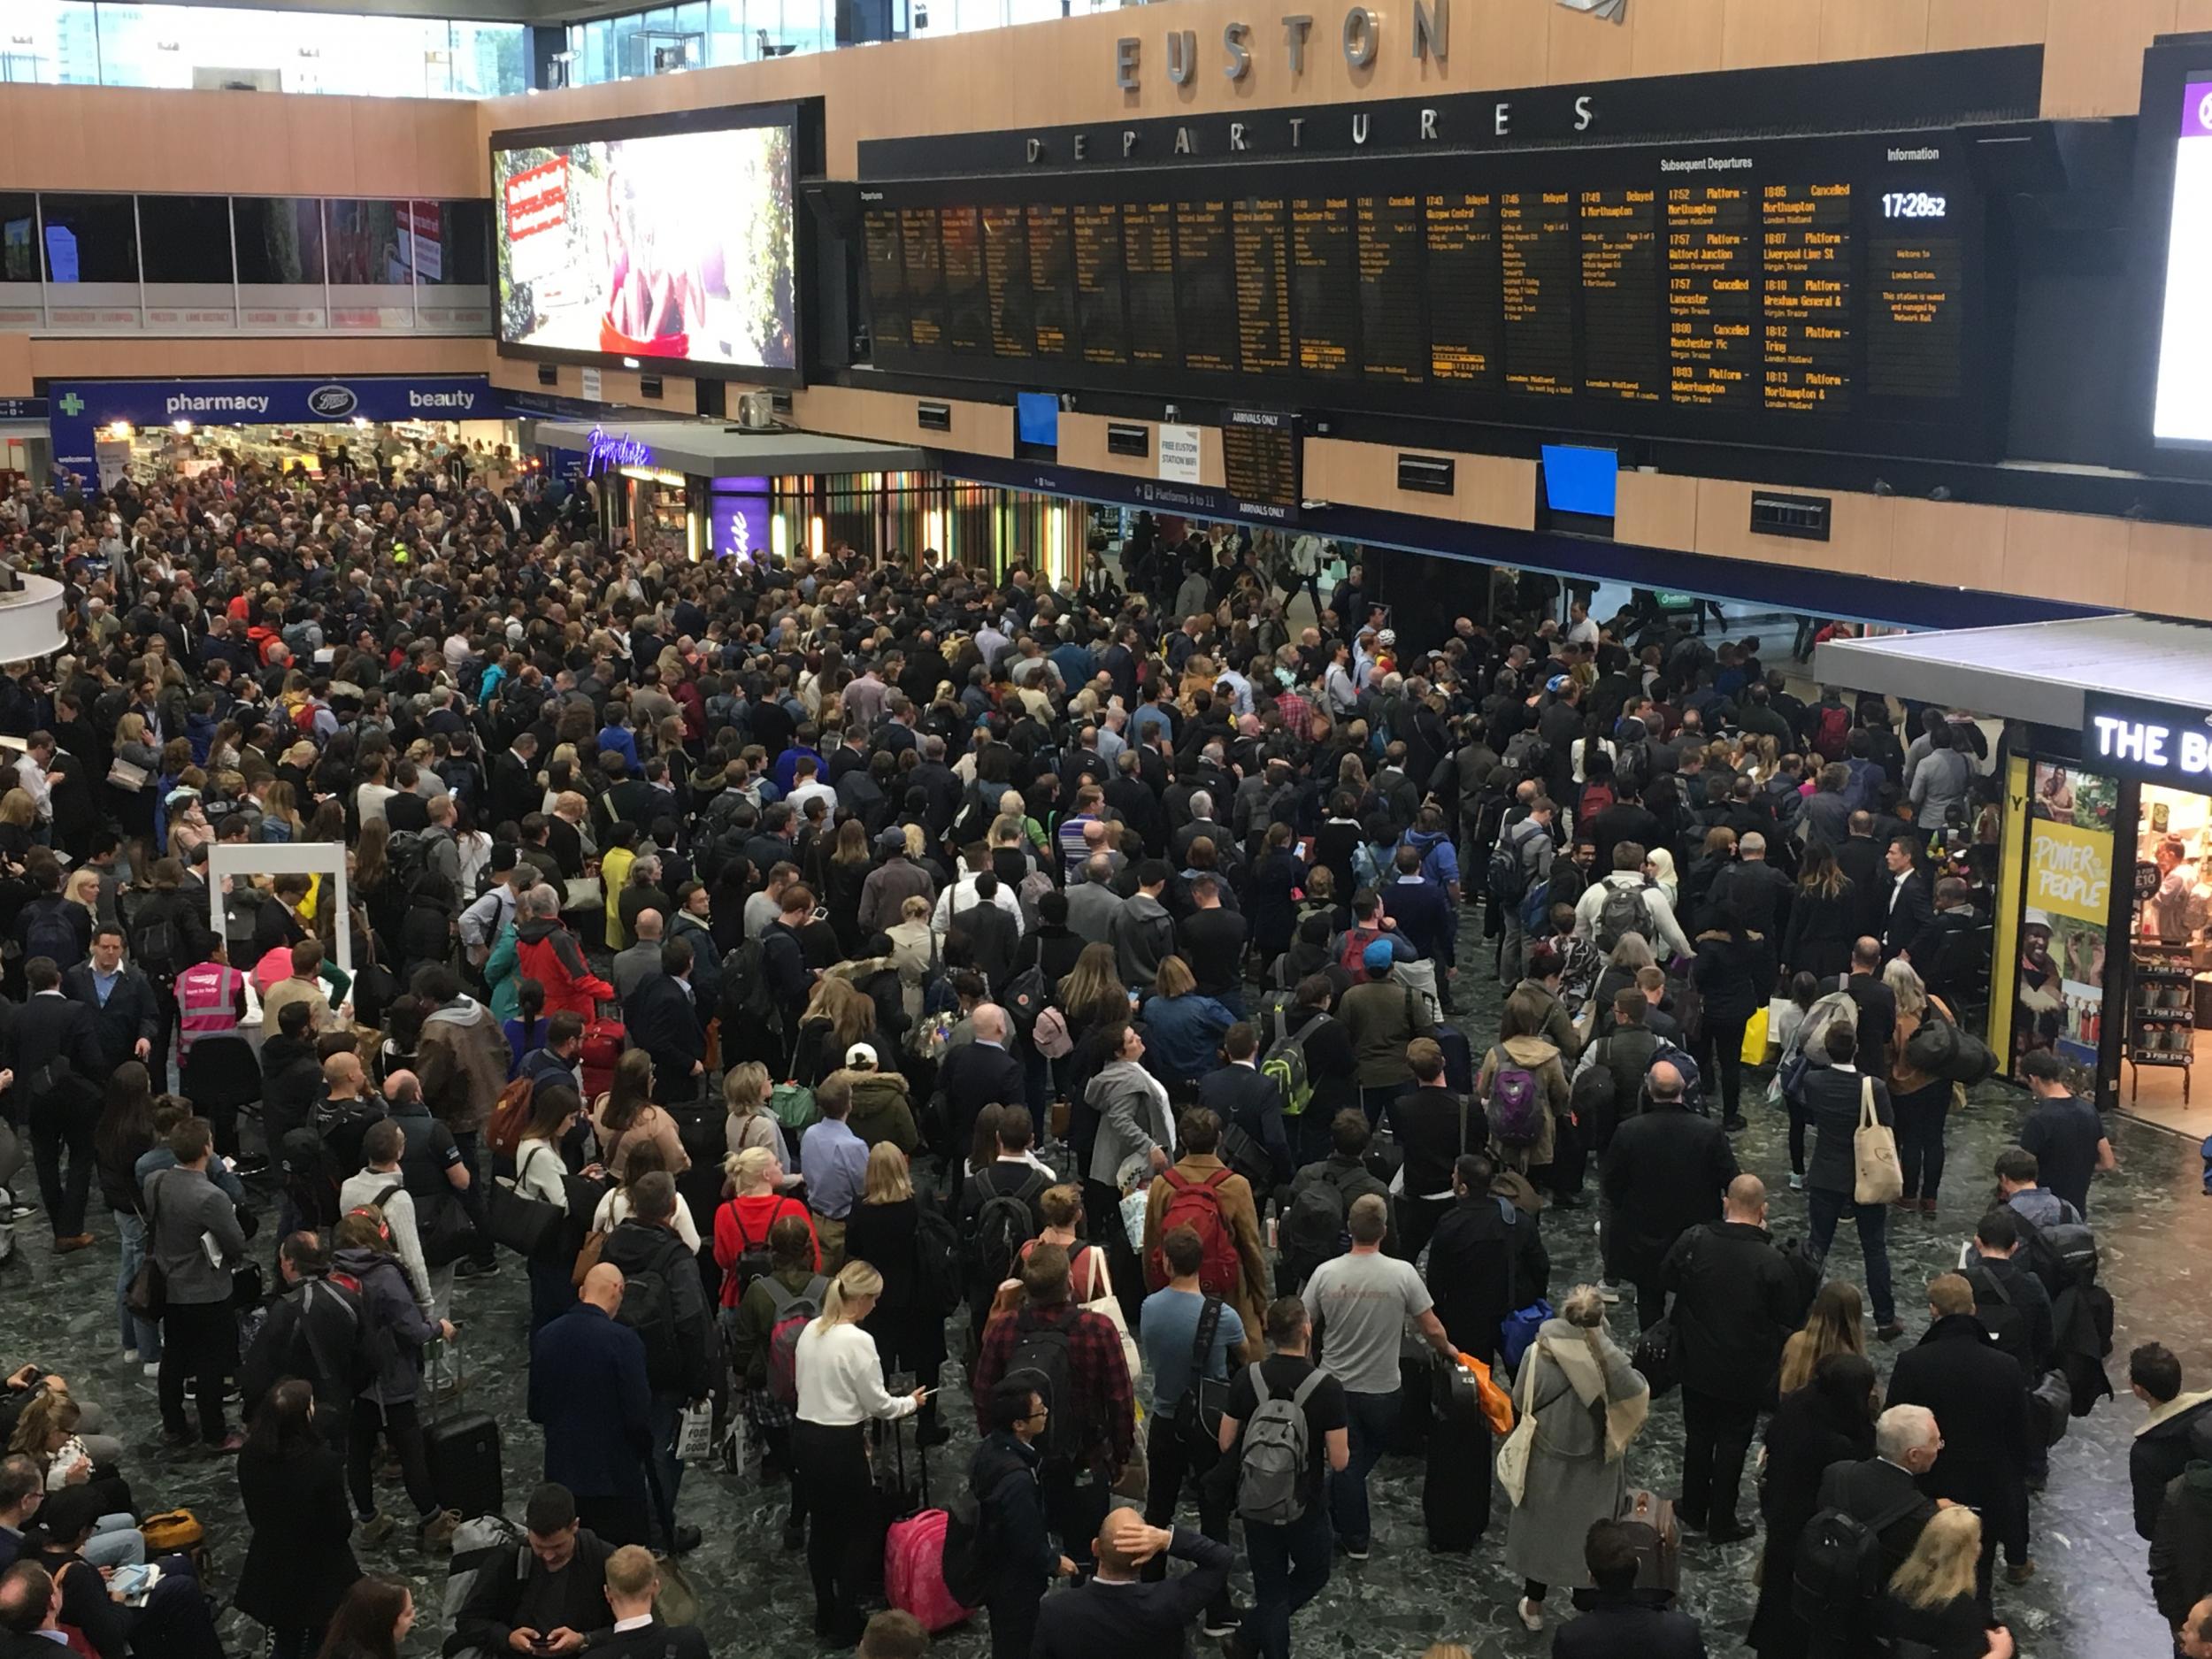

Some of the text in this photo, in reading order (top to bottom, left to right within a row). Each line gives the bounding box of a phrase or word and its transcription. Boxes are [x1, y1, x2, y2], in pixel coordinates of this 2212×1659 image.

[1117, 0, 1448, 88] EUSTON
[1026, 96, 1593, 164] DEPARTURES
[1887, 148, 1939, 161] Information
[1661, 157, 1753, 173] Subsequent Departures
[1707, 188, 1740, 199] Platform
[1810, 184, 1850, 196] Cancelled
[1542, 193, 1569, 204] Delayed
[1626, 190, 1655, 203] Delayed
[1501, 208, 1521, 218] Crewe
[1587, 206, 1633, 218] Northampton
[1668, 204, 1717, 215] Northampton
[1763, 203, 1815, 213] Northampton
[1707, 234, 1740, 244] Platform
[1805, 233, 1840, 243] Platform
[1669, 250, 1732, 259] Watford Junction
[1763, 249, 1801, 260] Liverpool
[1713, 280, 1748, 290] Cancelled
[1805, 280, 1840, 291] Platform
[1670, 294, 1709, 304] Lancaster
[1801, 296, 1832, 307] General
[1713, 325, 1749, 336] Cancelled
[1805, 326, 1841, 338] Platform
[1671, 337, 1713, 349] Manchester
[1765, 341, 1786, 353] Tring
[1709, 367, 1741, 380] Platform
[1806, 373, 1841, 385] Platform
[1671, 380, 1725, 394] Wolverhampton
[1764, 385, 1816, 400] Northampton
[166, 393, 269, 414] pharmacy
[409, 389, 475, 410] beauty
[1233, 412, 1279, 426] ARRIVALS ONLY
[1162, 441, 1198, 453] FREE EUSTON
[1162, 454, 1184, 465] STATION
[1156, 488, 1188, 504] Platforms
[1195, 495, 1204, 505] to
[1205, 495, 1216, 508] 11
[1240, 503, 1285, 518] ARRIVALS ONLY
[2094, 716, 2212, 773] THE B
[2034, 835, 2094, 879] POWER
[2039, 870, 2108, 908] PEOPLE
